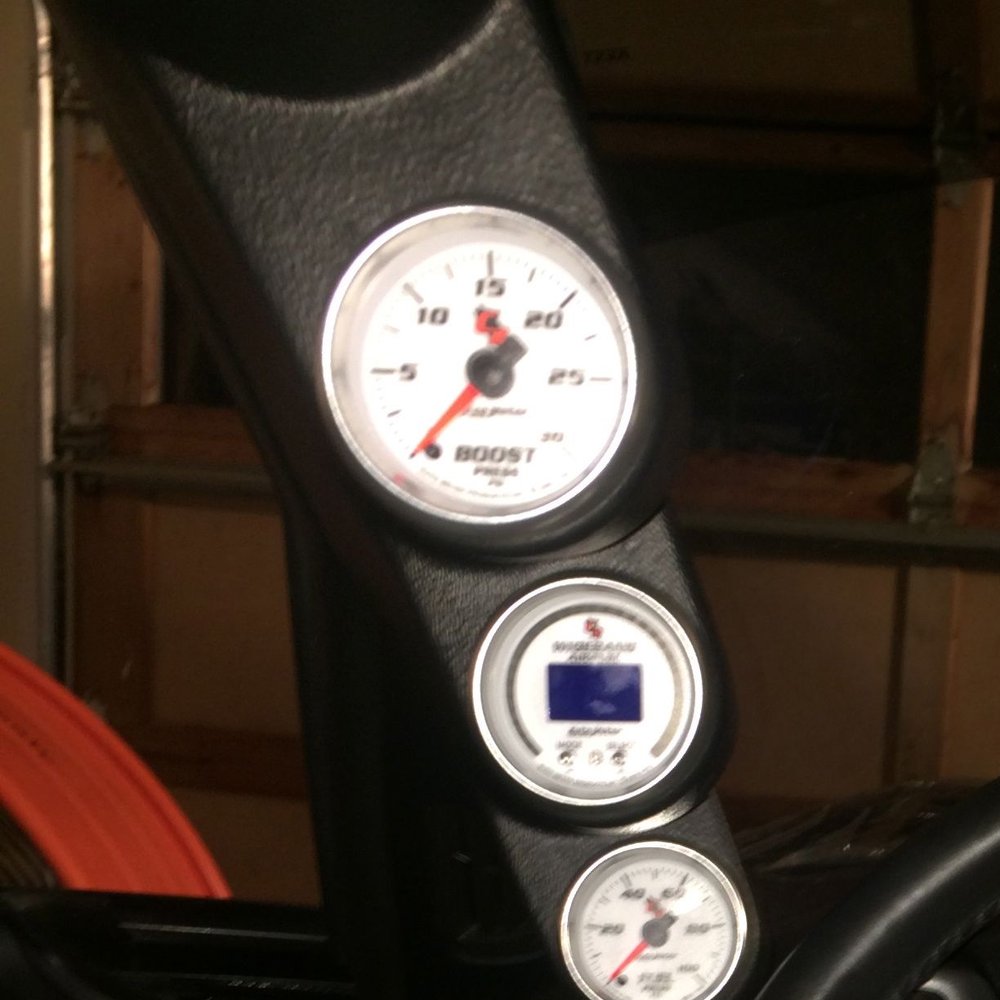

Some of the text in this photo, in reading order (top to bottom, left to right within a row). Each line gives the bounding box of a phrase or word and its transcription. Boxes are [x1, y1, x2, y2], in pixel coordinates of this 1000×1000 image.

[475, 278, 506, 297] 15
[417, 307, 449, 325] 10
[524, 310, 563, 330] 20
[399, 363, 417, 381] 5
[548, 369, 584, 386] 25
[454, 444, 537, 464] BOOST
